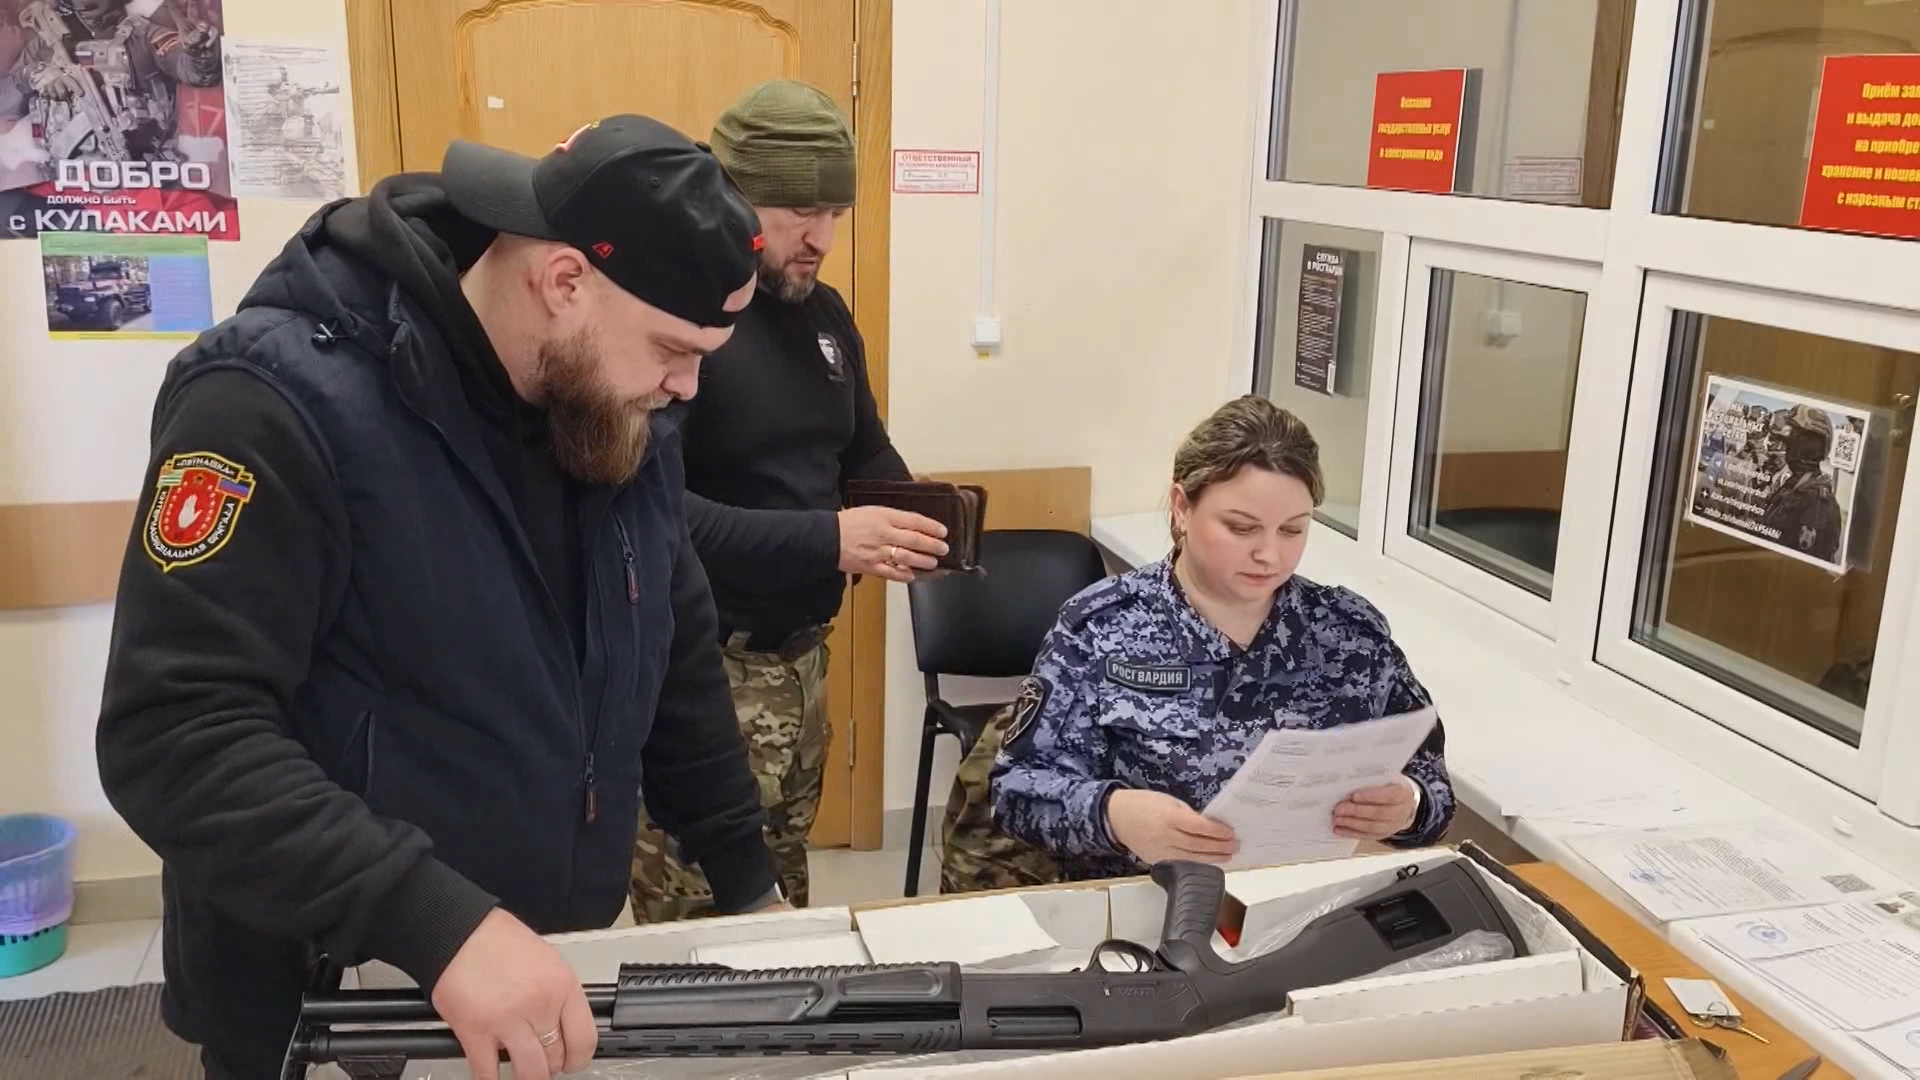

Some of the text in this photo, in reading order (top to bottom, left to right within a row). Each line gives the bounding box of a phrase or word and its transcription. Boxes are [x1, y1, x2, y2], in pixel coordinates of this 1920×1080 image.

[1862, 82, 1900, 99] Приём
[1846, 112, 1855, 125] и
[1856, 112, 1901, 127] выдача
[1855, 139, 1869, 152] на
[55, 160, 211, 192] ДОБРО
[1821, 165, 1873, 180] хранение
[1874, 167, 1883, 180] и
[1837, 191, 1920, 211] с нарезным ст
[35, 209, 228, 233] КУЛАКАМИ
[1112, 663, 1184, 686] РОСГВАРДИЯ
